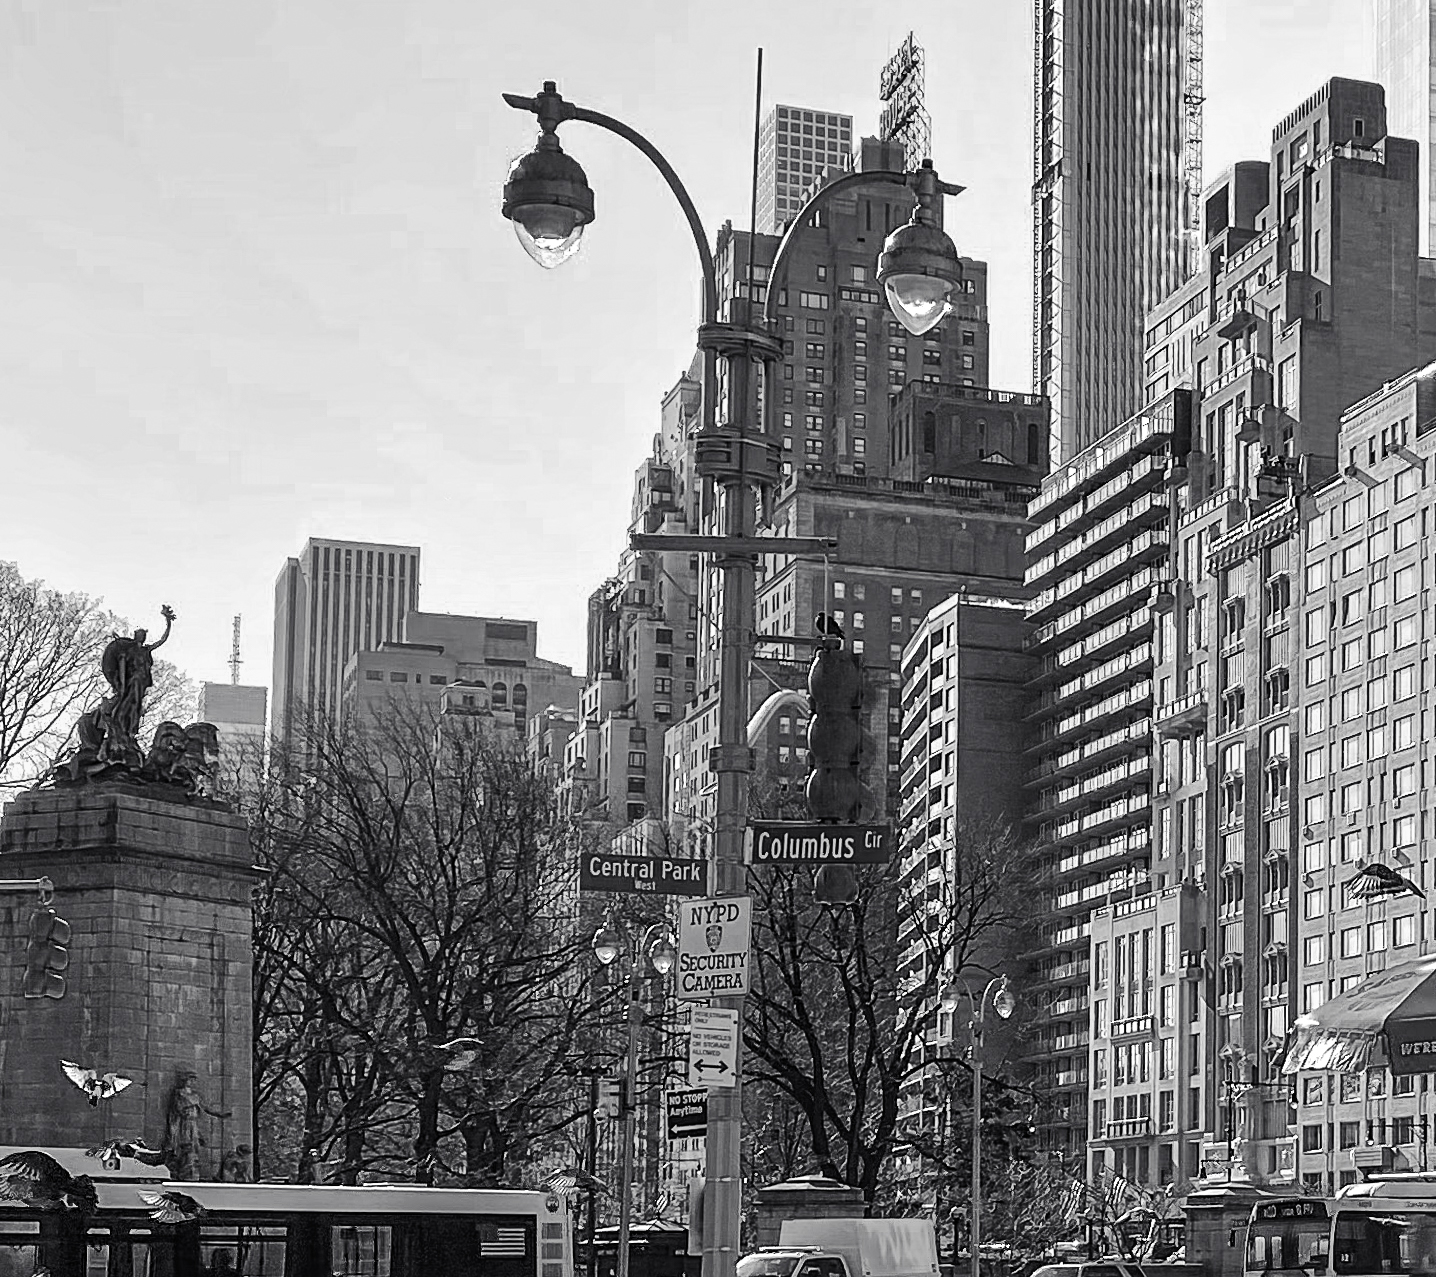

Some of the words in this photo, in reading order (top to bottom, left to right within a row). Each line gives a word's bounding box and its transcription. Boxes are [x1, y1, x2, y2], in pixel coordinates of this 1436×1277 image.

[758, 831, 855, 860] Columbus
[864, 830, 883, 848] Cir
[589, 856, 655, 880] Central
[661, 860, 702, 882] Park
[634, 880, 656, 891] West
[689, 903, 740, 926] NYPD
[680, 951, 748, 972] SECURITY
[682, 972, 744, 993] CAMERA
[669, 1096, 681, 1105] NO
[670, 1106, 703, 1117] Anytime
